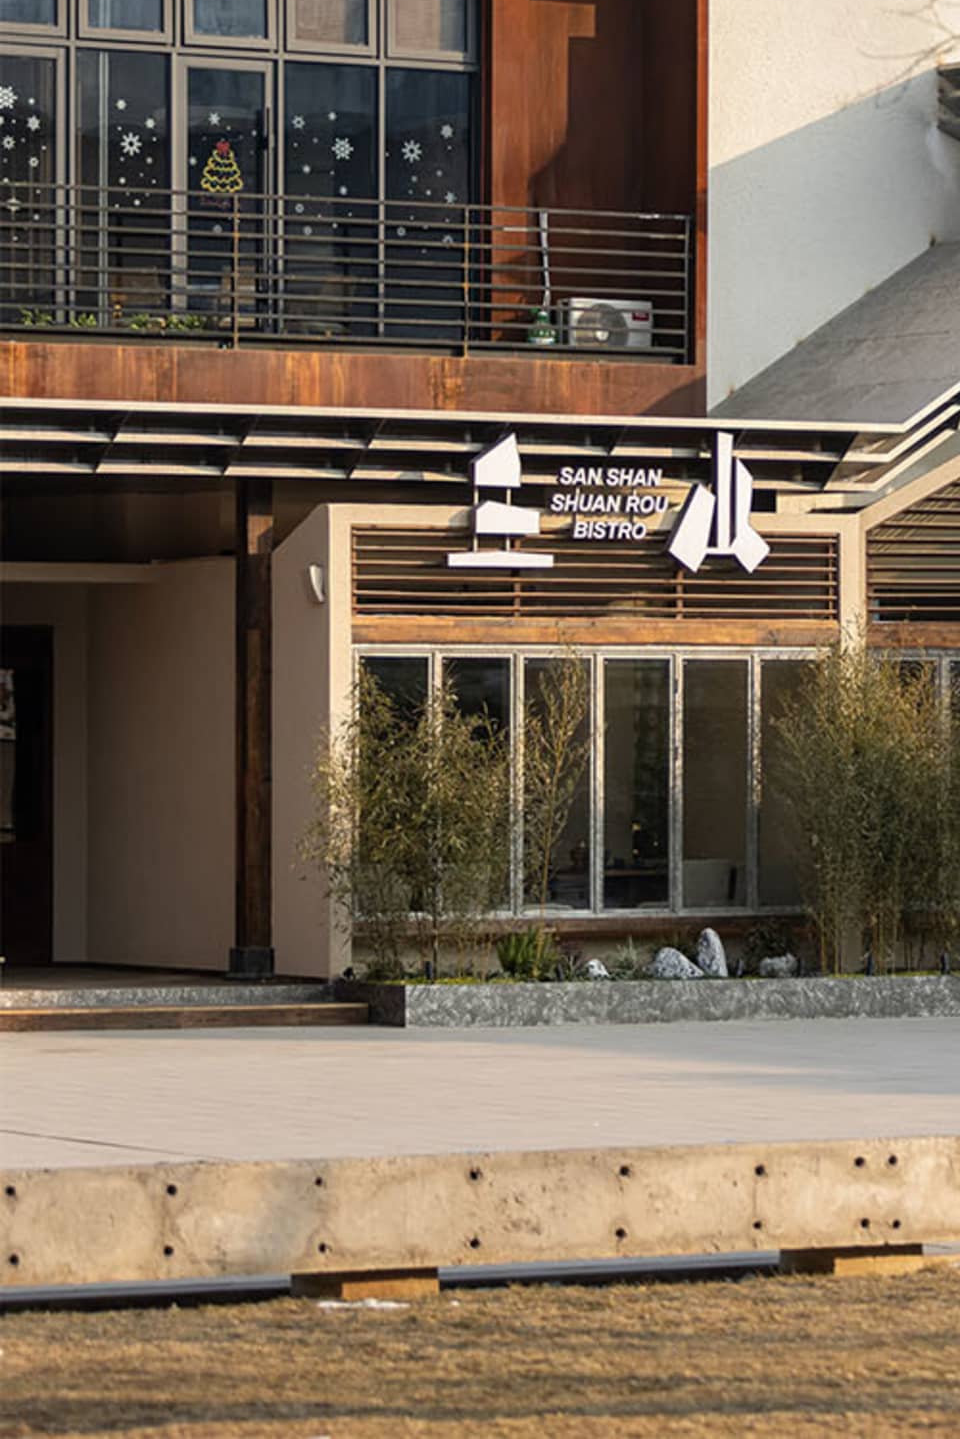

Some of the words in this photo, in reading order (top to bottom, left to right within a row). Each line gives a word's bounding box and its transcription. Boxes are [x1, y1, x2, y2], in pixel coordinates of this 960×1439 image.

[560, 466, 603, 486] SAN
[605, 467, 663, 487] SHAN
[550, 493, 622, 513] SHUAN
[625, 494, 669, 514] ROU
[572, 520, 647, 540] BISTRO
